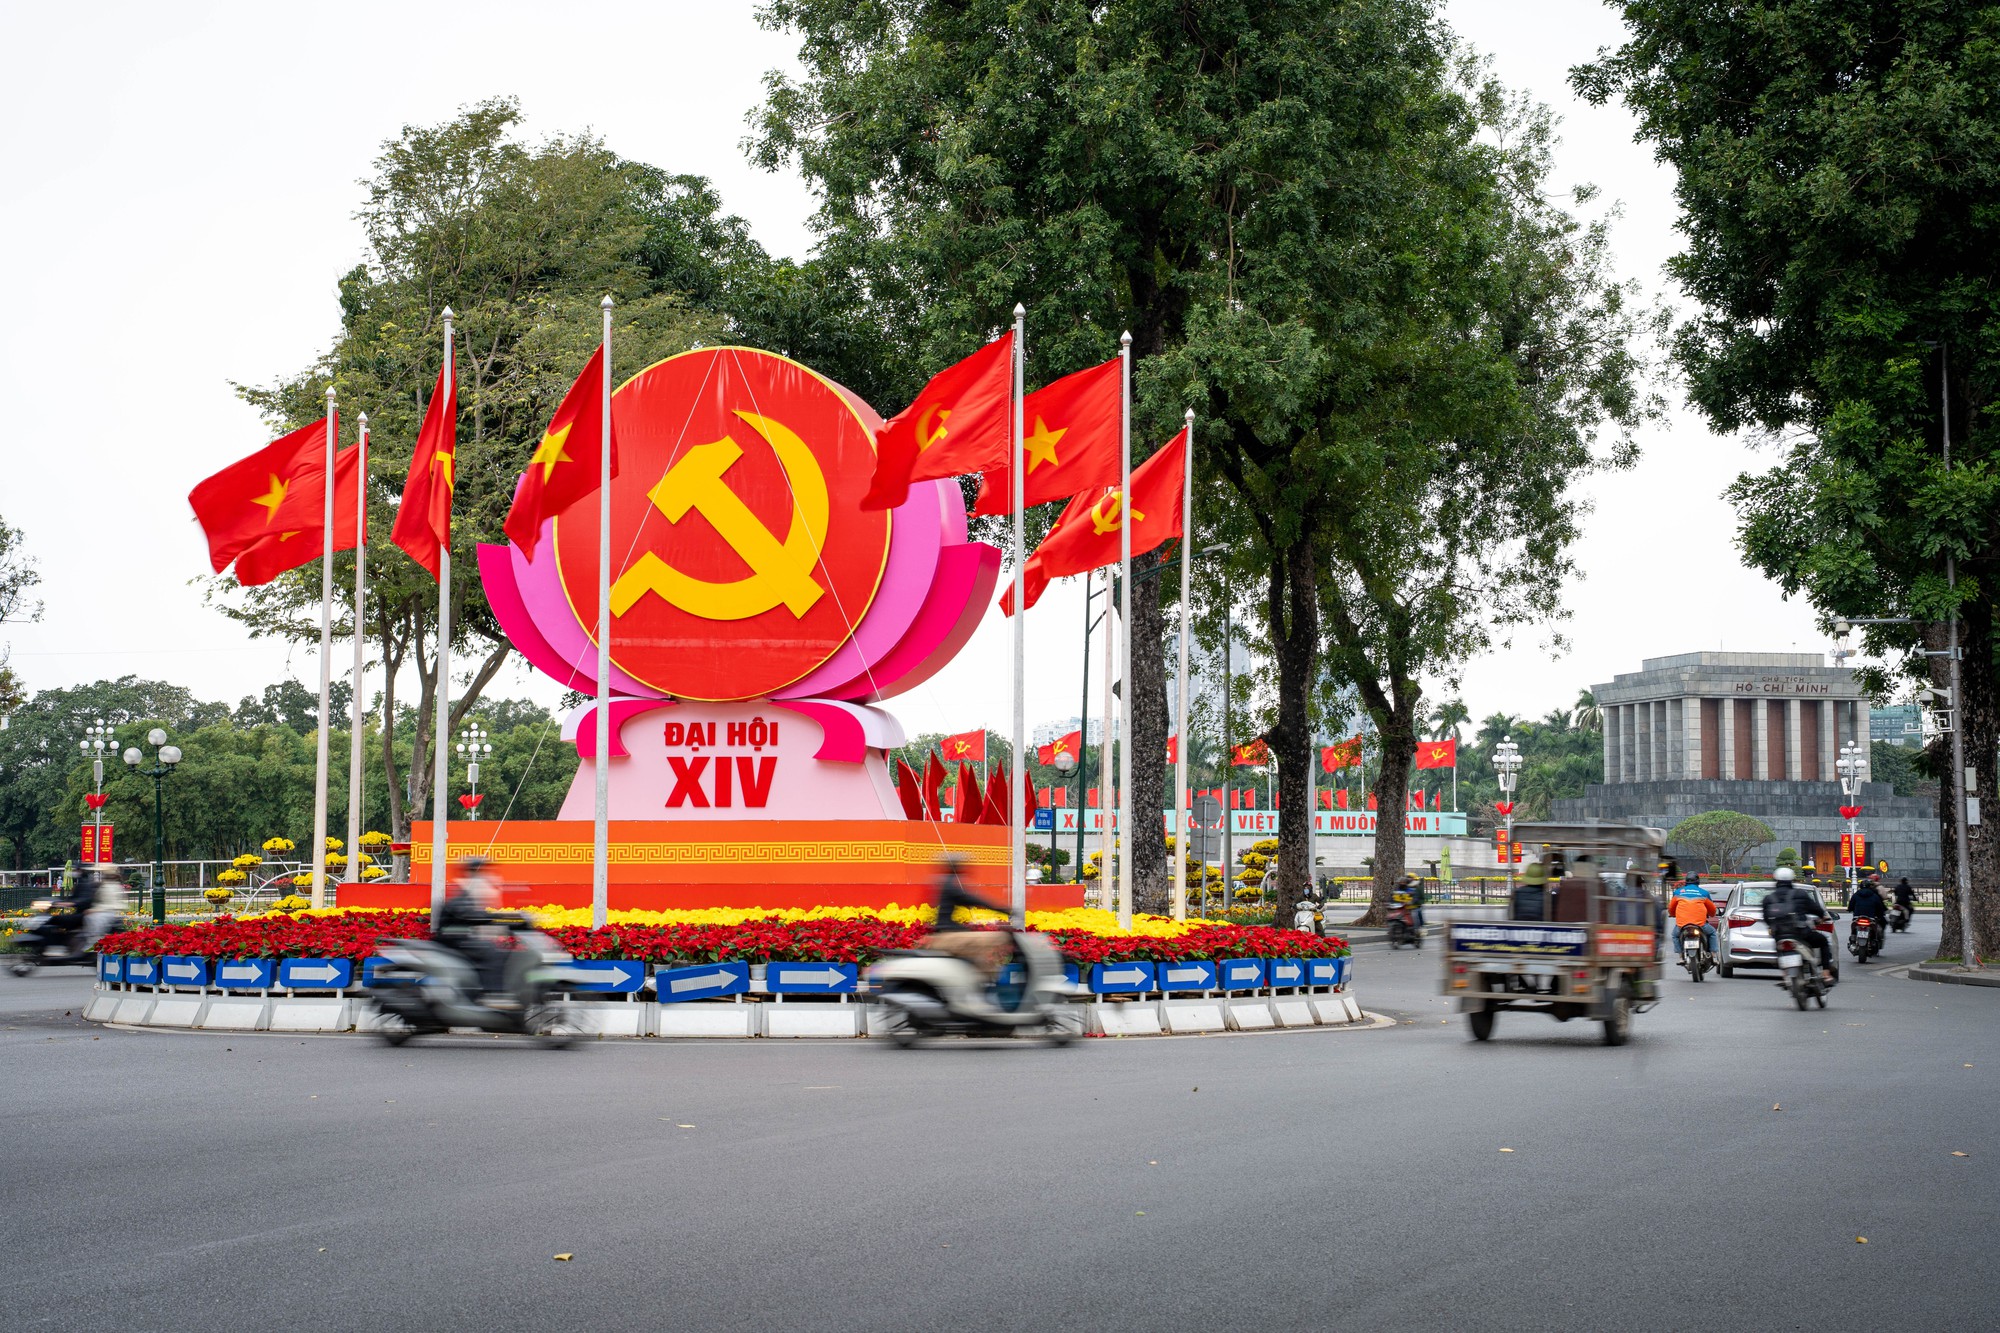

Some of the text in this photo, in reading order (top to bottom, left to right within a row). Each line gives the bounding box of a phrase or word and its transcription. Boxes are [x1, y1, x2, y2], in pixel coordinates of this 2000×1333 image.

[664, 717, 778, 752] ĐẠI HỘI
[665, 756, 778, 808] XIV
[1237, 812, 1276, 832] VIỆT
